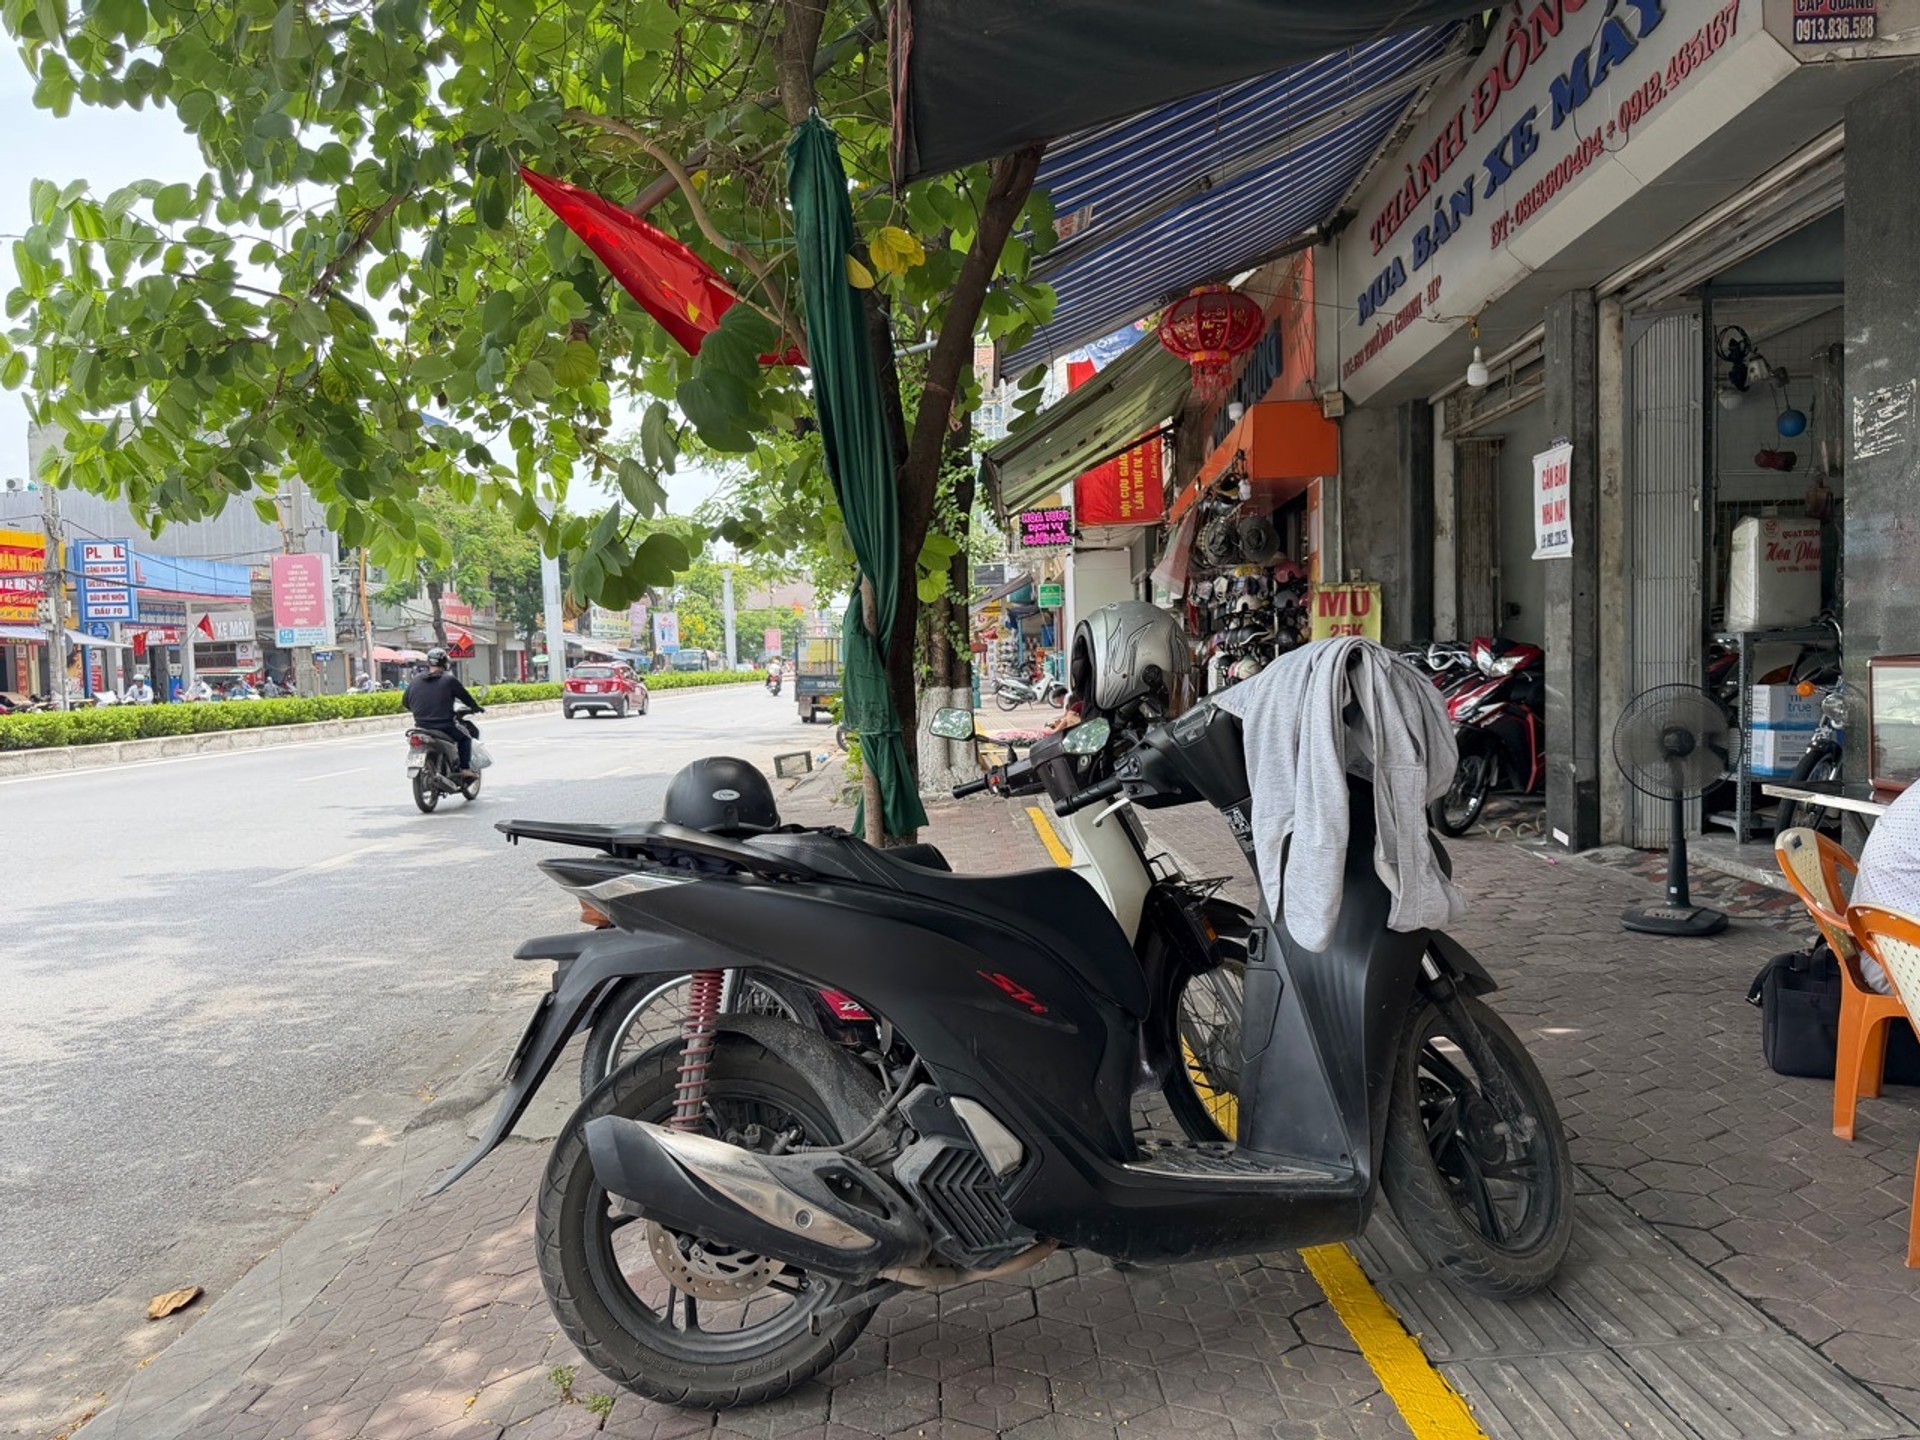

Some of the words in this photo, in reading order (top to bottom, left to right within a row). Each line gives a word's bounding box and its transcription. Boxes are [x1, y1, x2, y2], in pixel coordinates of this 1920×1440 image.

[1796, 16, 1874, 41] 0913.836.588
[1369, 104, 1467, 257] THÀNH
[1470, 0, 1584, 134] ĐỒN
[1358, 256, 1407, 327] MUA
[1412, 173, 1475, 271] BÁN
[1483, 105, 1539, 199] XE
[1318, 586, 1370, 617] MŨ
[1330, 624, 1363, 637] 25K
[1788, 703, 1811, 712] true
